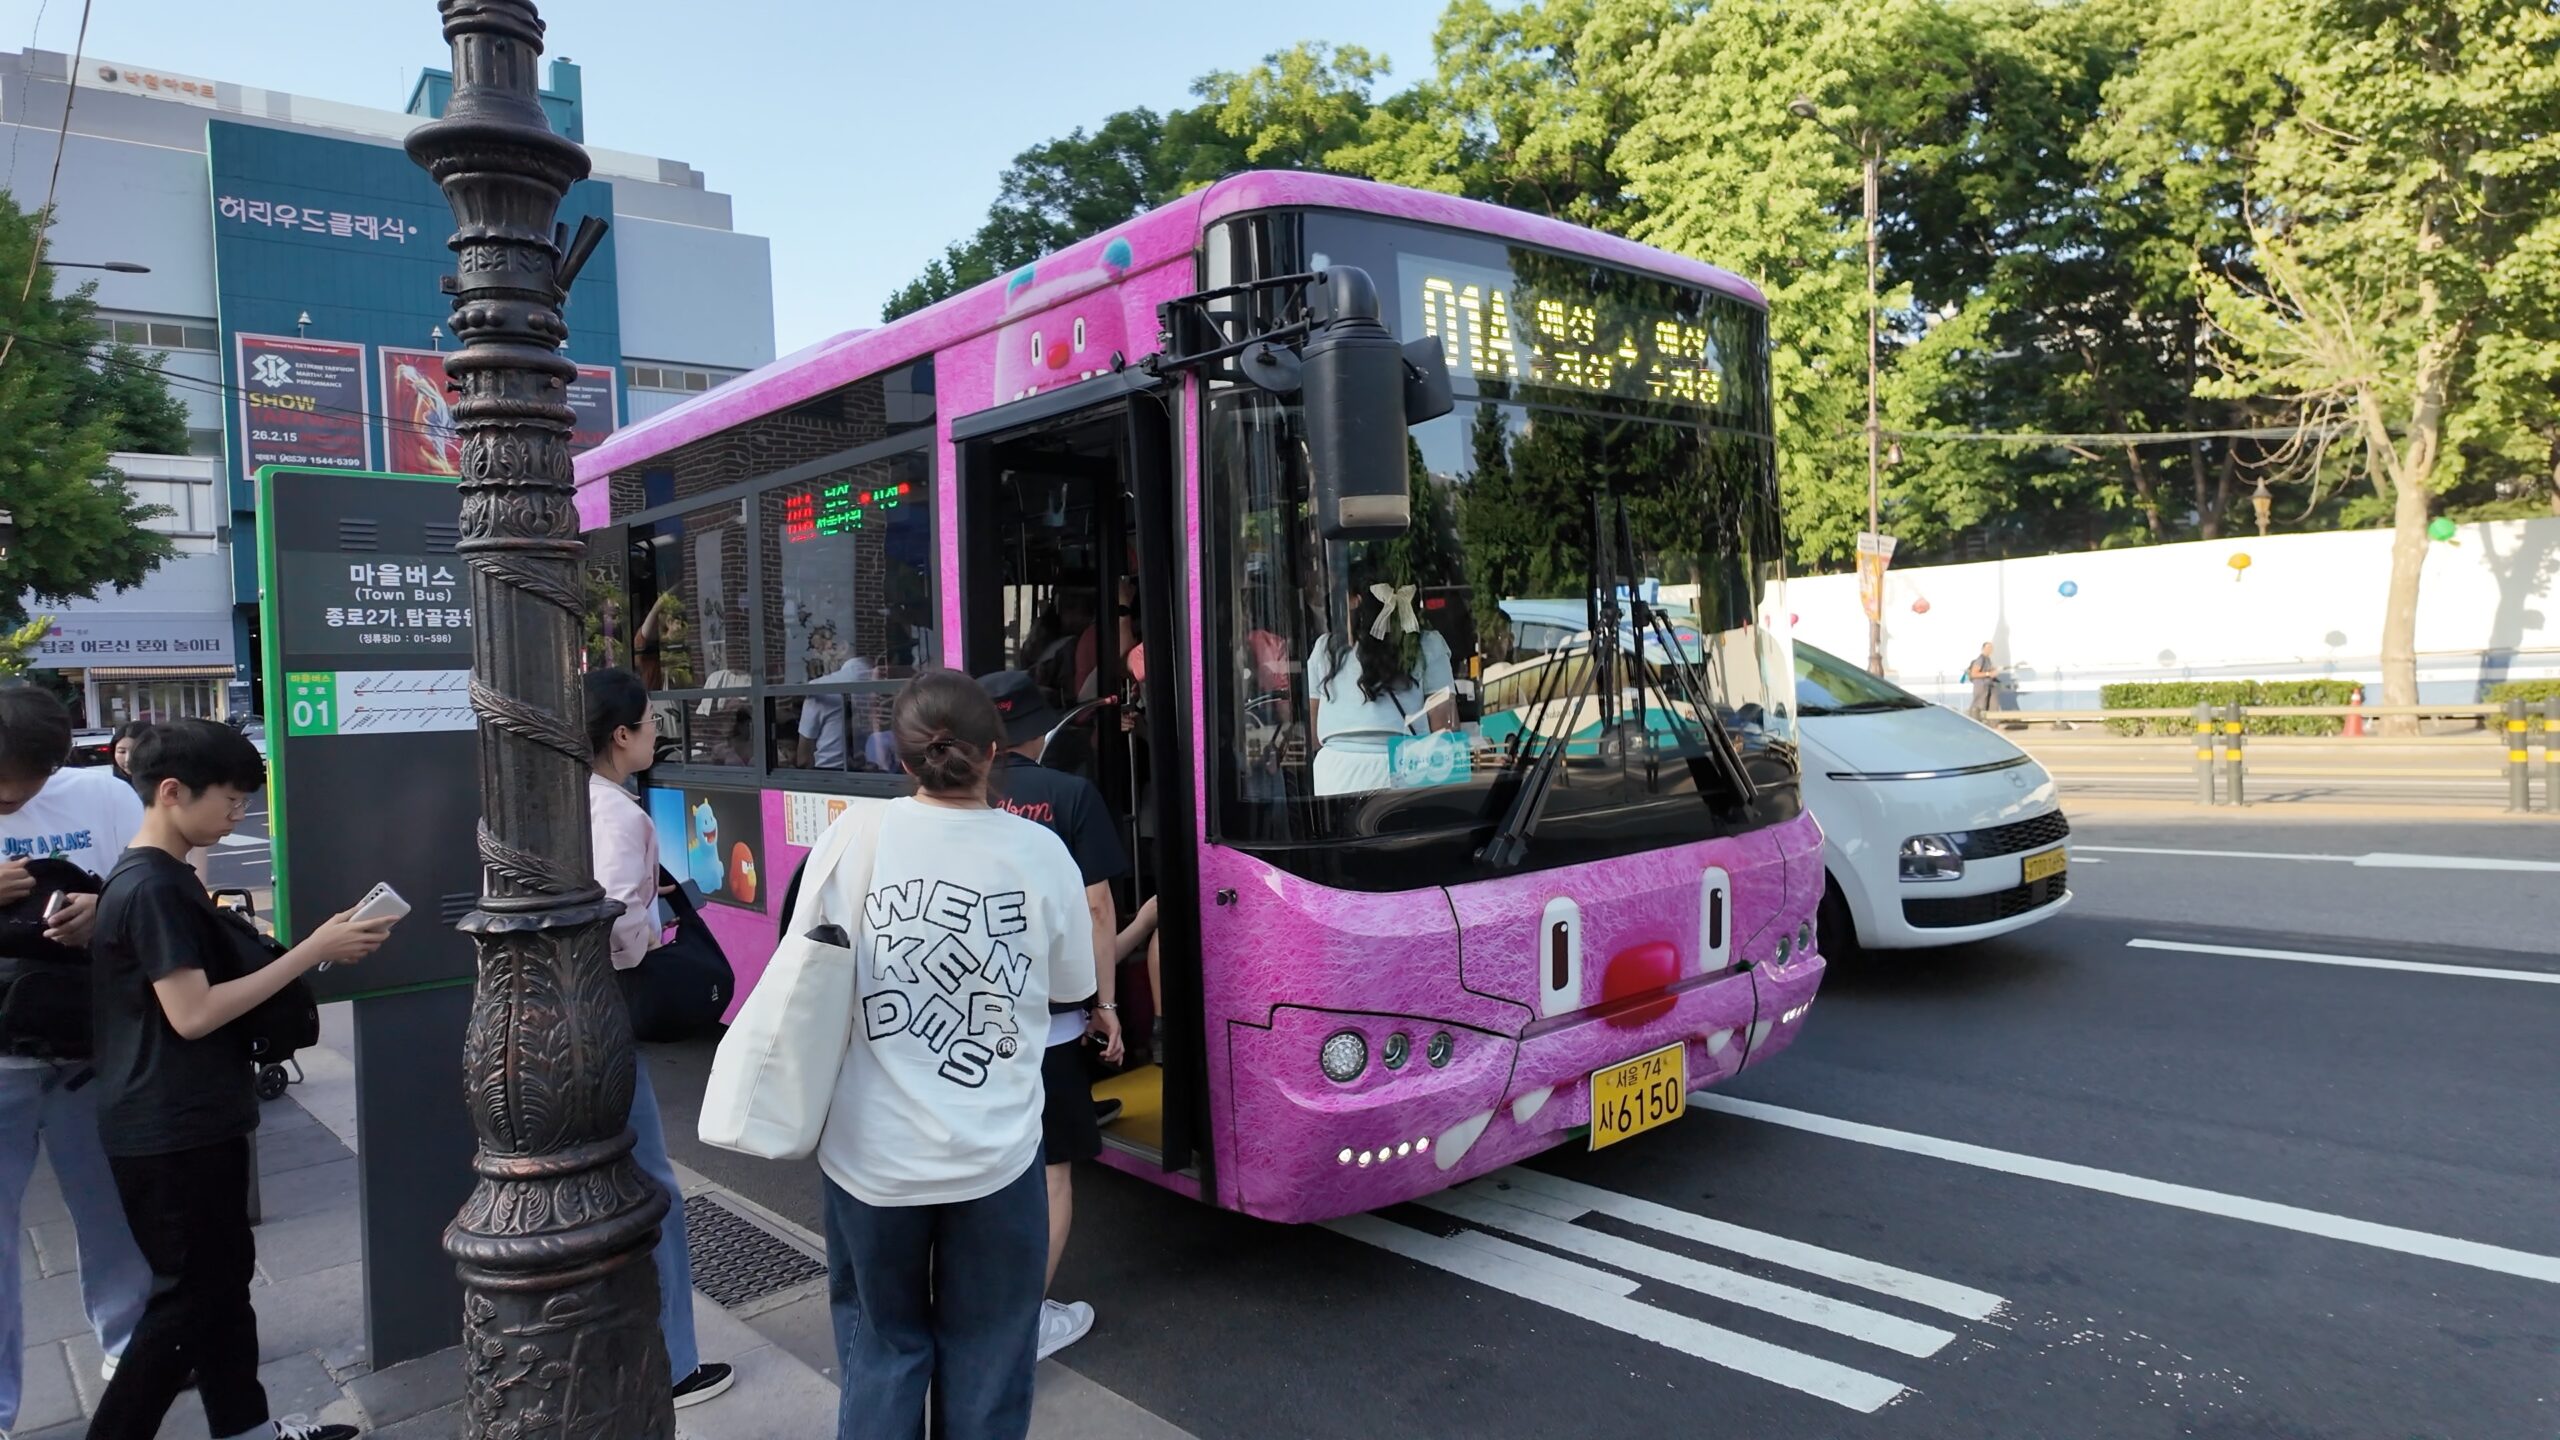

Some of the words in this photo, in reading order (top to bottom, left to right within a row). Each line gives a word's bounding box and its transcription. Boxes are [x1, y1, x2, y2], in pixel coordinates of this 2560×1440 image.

[218, 196, 404, 244] 허리우드클래식
[249, 392, 316, 411] SHOW
[252, 430, 298, 442] 26.2.15
[350, 563, 456, 586] 마을버스
[355, 587, 405, 602] (Town
[414, 589, 452, 602] Bus)
[81, 640, 130, 652] 어르신
[136, 639, 169, 652] 문화
[173, 638, 220, 651] 놀이터
[293, 700, 329, 727] 01
[2, 837, 34, 856] JUST
[37, 835, 50, 854] A
[49, 830, 92, 852] PLACE
[1616, 1066, 1638, 1088] 서울
[1642, 1057, 1661, 1080] 74
